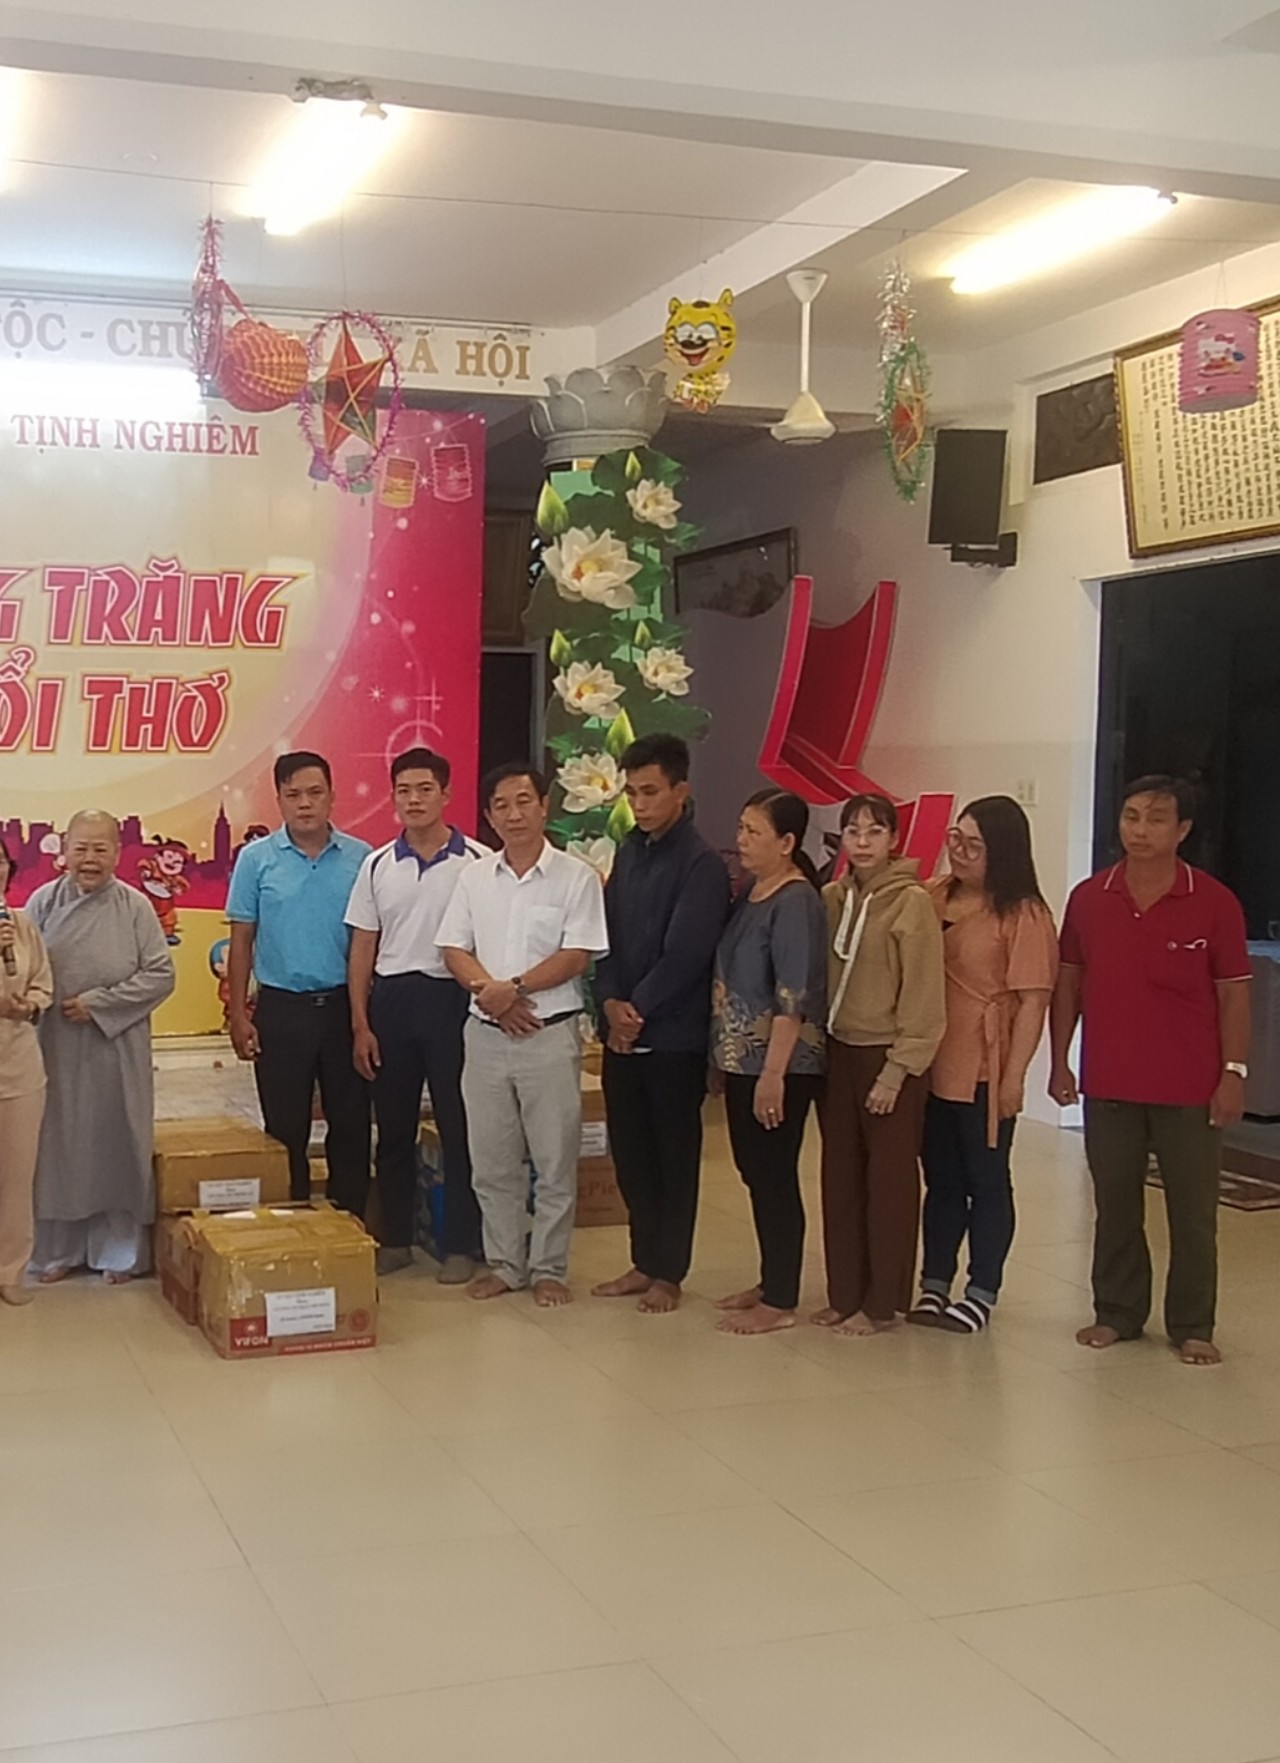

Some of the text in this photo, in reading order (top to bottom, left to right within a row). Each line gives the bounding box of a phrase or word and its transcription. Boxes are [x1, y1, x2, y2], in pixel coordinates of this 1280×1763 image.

[455, 334, 531, 386] HỘI
[16, 414, 101, 454] TỊNH
[113, 413, 260, 456] NGHIÊM
[42, 557, 300, 648] TRĂNG
[82, 671, 232, 753] THƠ
